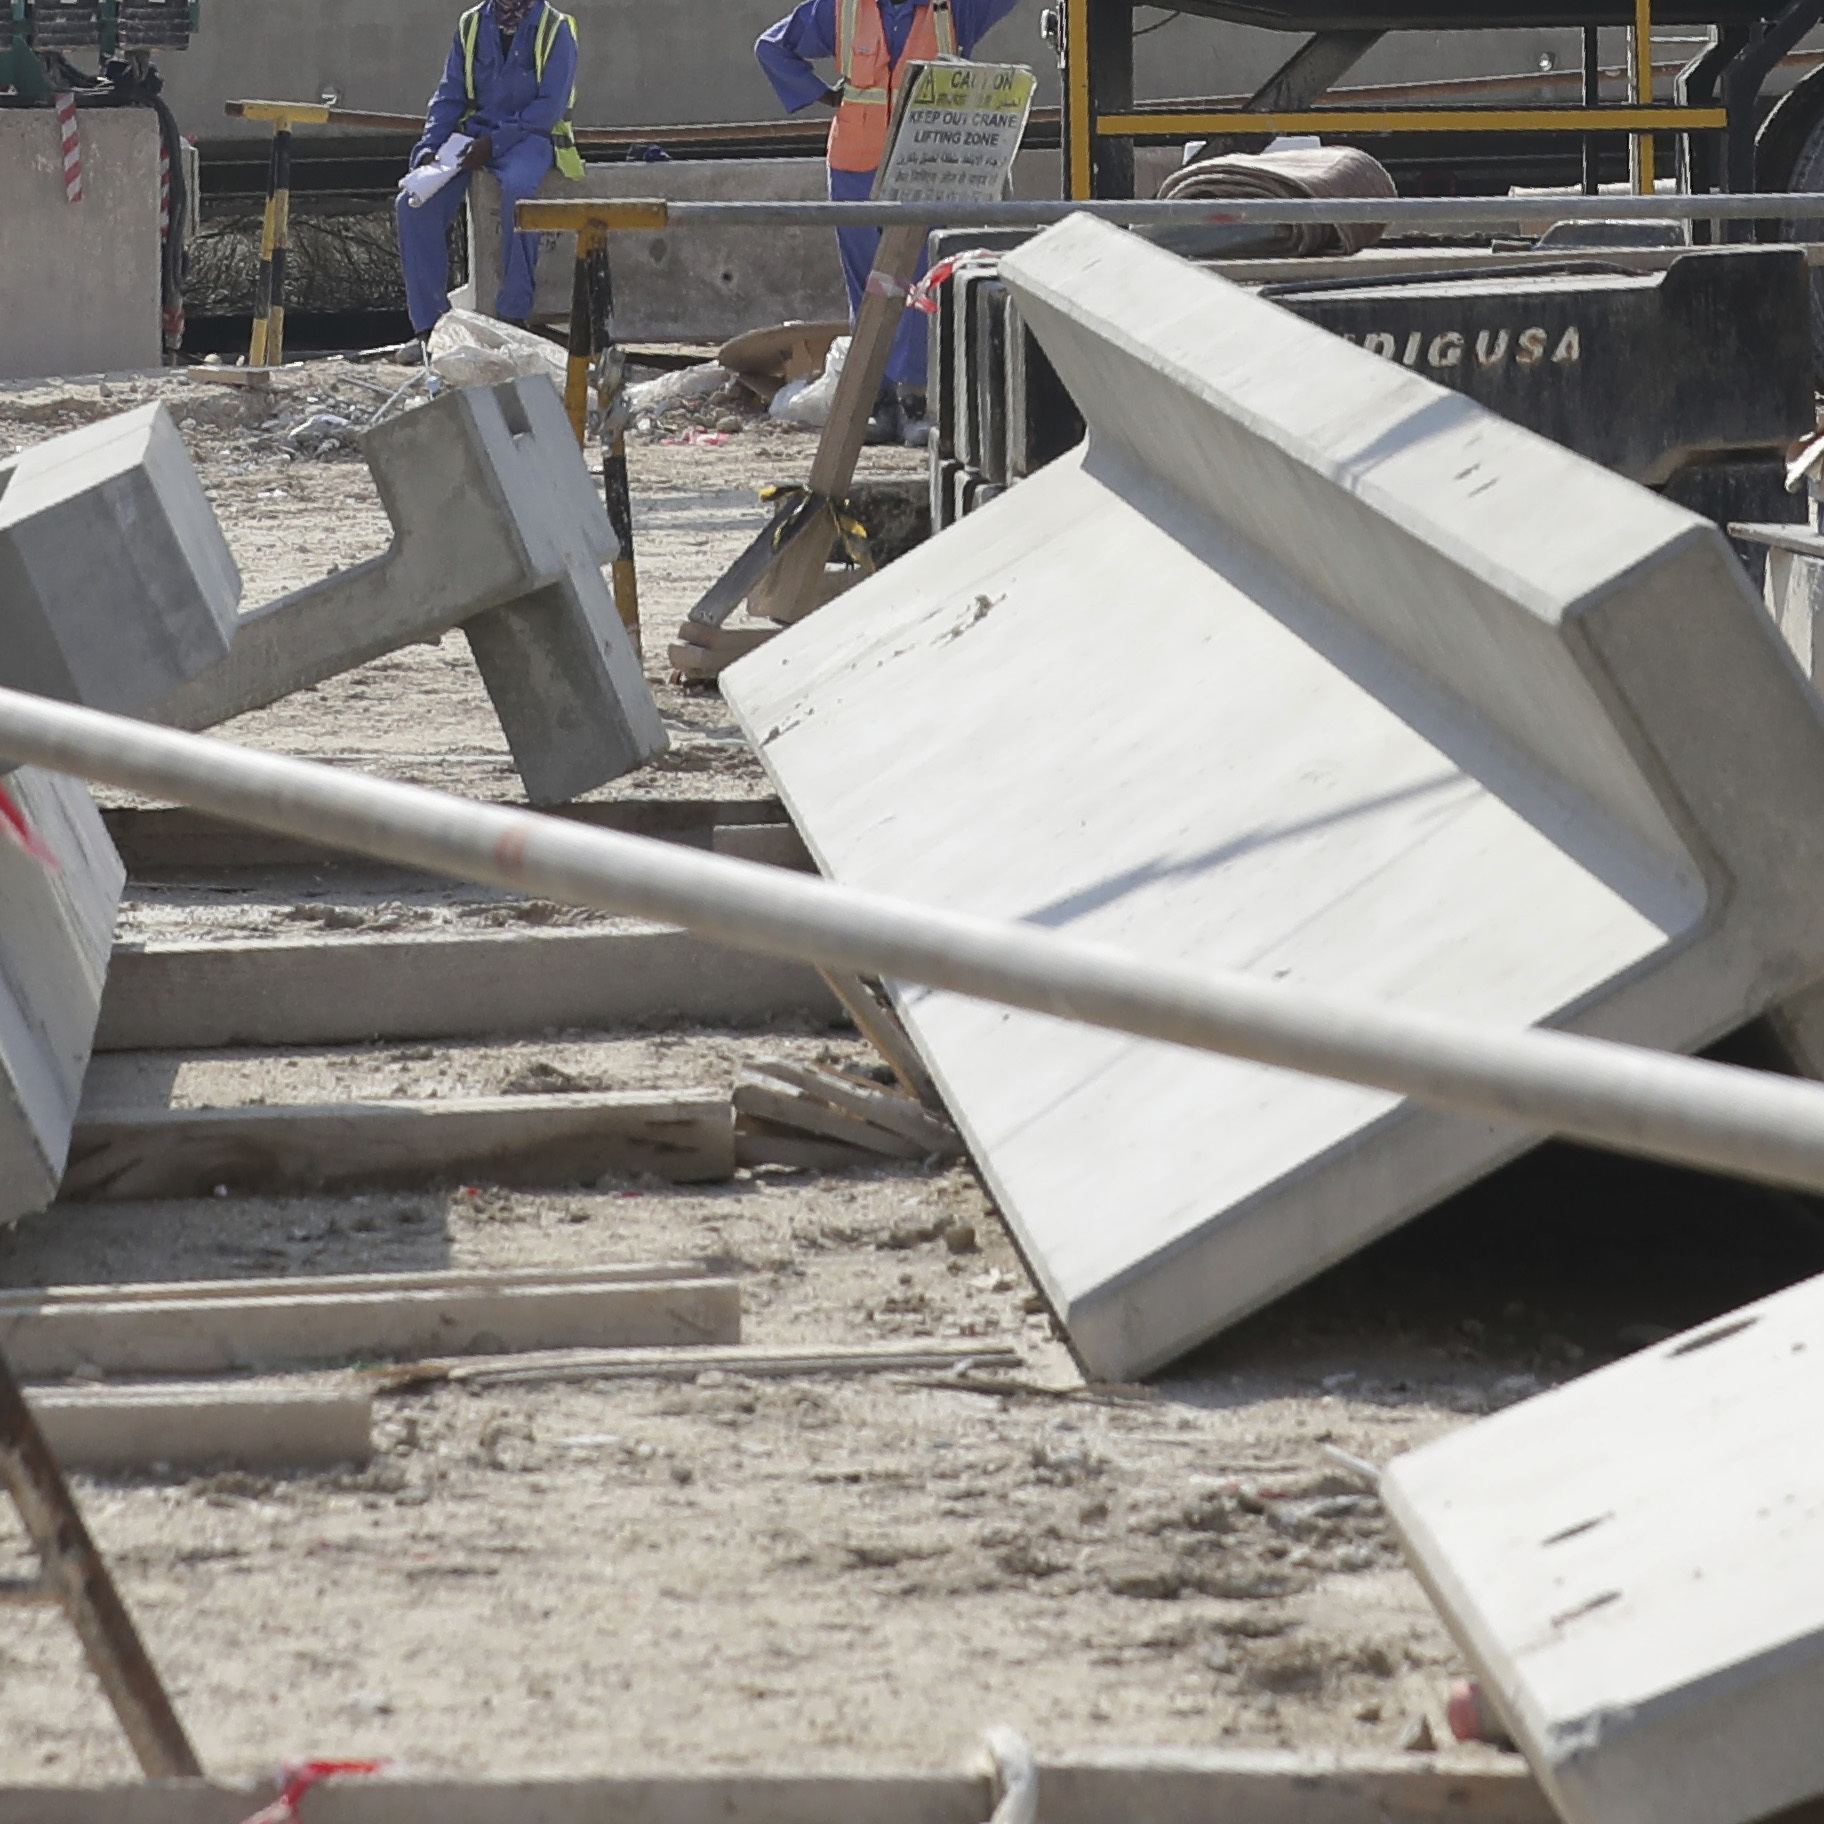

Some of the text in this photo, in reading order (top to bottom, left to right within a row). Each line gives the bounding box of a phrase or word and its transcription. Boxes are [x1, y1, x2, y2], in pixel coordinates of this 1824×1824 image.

[950, 68, 1016, 91] CAON
[908, 110, 941, 125] KEEP
[971, 113, 1019, 128] CRANE
[913, 129, 1001, 146] LIFTING ZONE
[1343, 324, 1582, 368] DIGUSA
